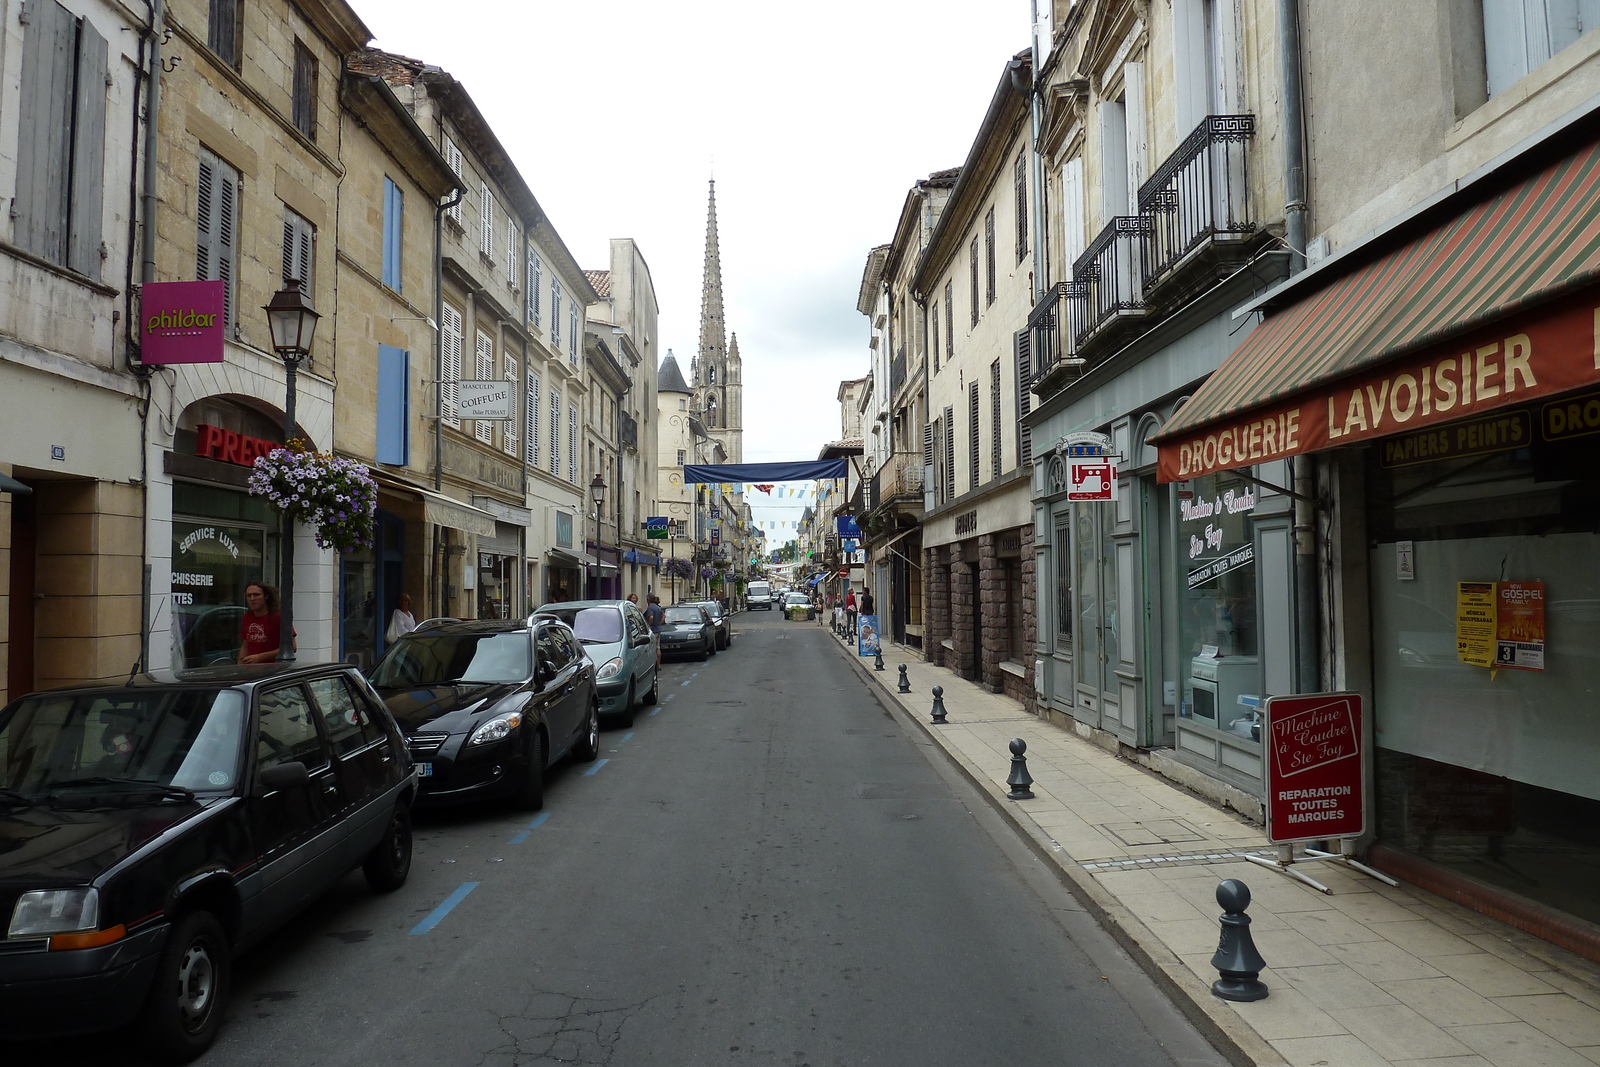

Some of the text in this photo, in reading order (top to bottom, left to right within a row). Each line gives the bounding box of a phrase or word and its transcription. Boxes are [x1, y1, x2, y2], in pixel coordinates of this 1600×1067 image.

[147, 309, 217, 333] phildar
[461, 390, 508, 408] COIFFURE
[1178, 408, 1300, 476] DROGUERIE
[1327, 333, 1538, 440] LAVOISIER
[1385, 417, 1522, 463] PAPIERS PEINTS
[1181, 495, 1213, 522] Machine
[1223, 486, 1255, 514] Coudre
[179, 527, 239, 559] SERVICE LUXE
[1189, 523, 1223, 559] Ste Foy
[1212, 559, 1228, 575] TOUTES
[1229, 547, 1253, 567] MARQUES
[1501, 589, 1543, 600] GOSPEL
[1502, 647, 1511, 661] 3
[1276, 710, 1343, 737] Machine
[1279, 723, 1350, 754] à Coudre
[1290, 742, 1345, 768] Ste Foy
[1278, 785, 1351, 801] REPARATION
[1292, 798, 1338, 812] TOUTES
[1287, 809, 1345, 824] MARQUES
